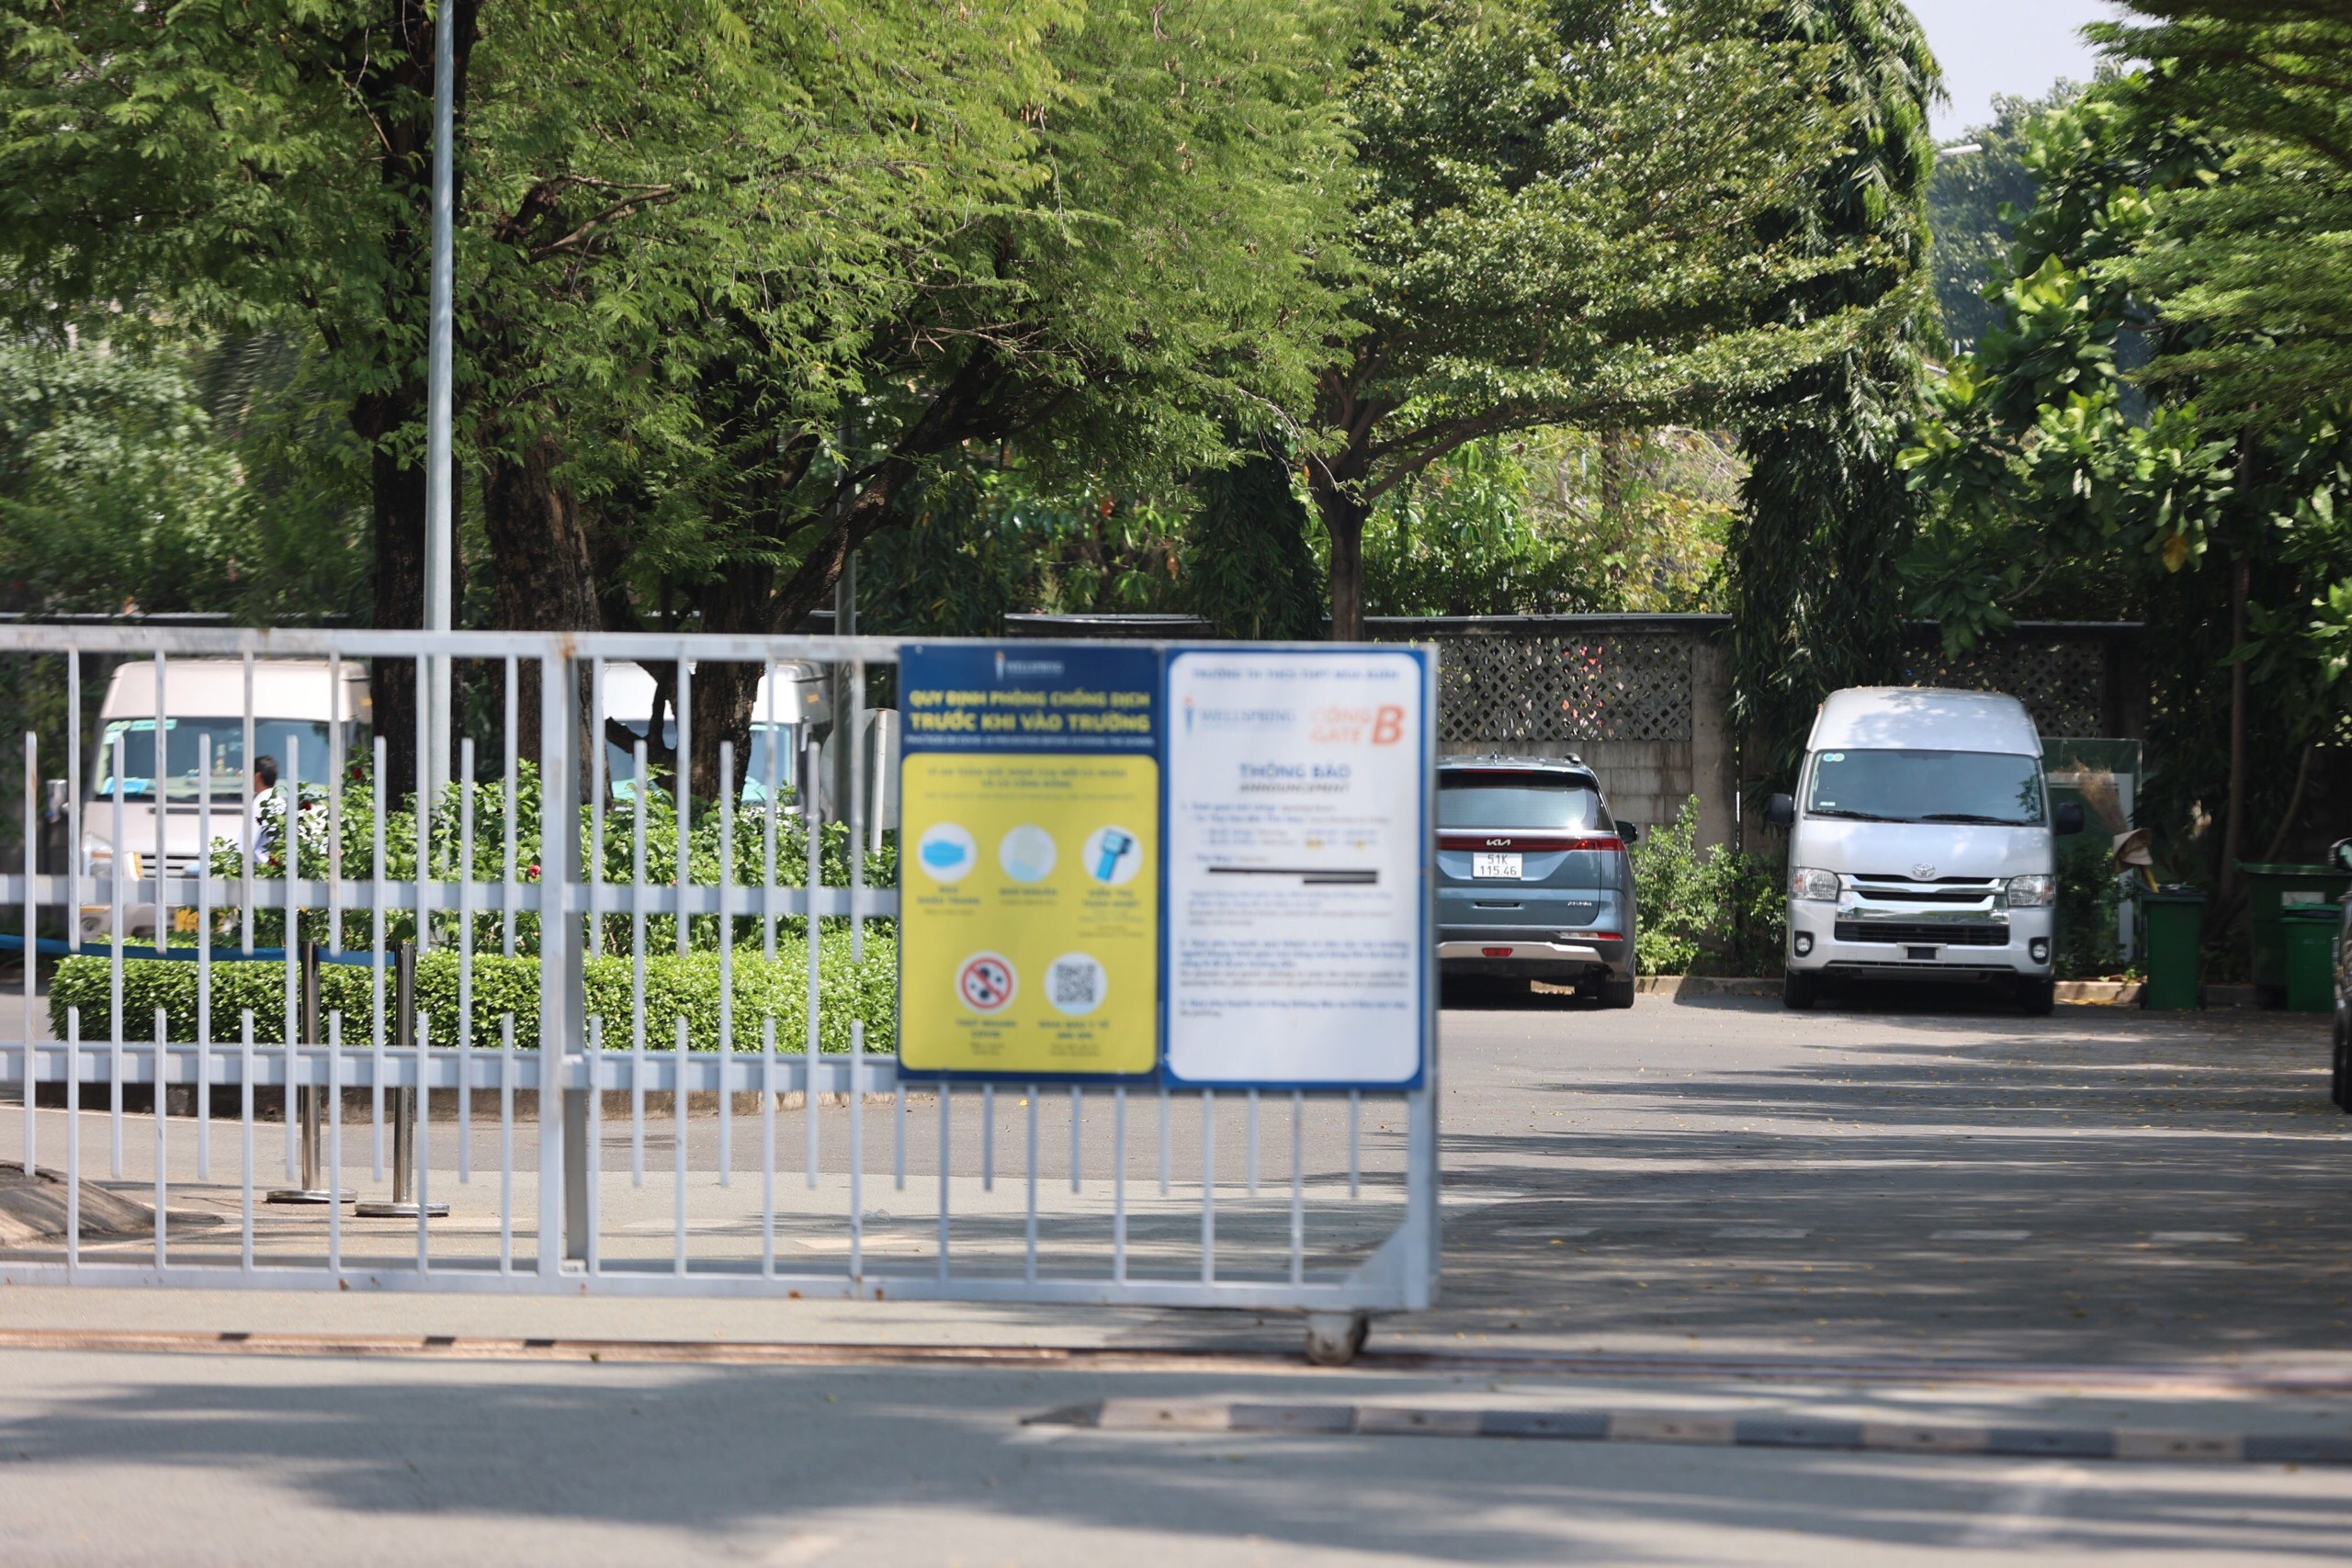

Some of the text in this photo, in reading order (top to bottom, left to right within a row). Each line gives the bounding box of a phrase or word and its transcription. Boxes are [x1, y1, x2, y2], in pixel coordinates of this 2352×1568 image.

[1372, 705, 1405, 746] B
[1487, 854, 1508, 864] 51K
[1480, 865, 1517, 876] 115.46
